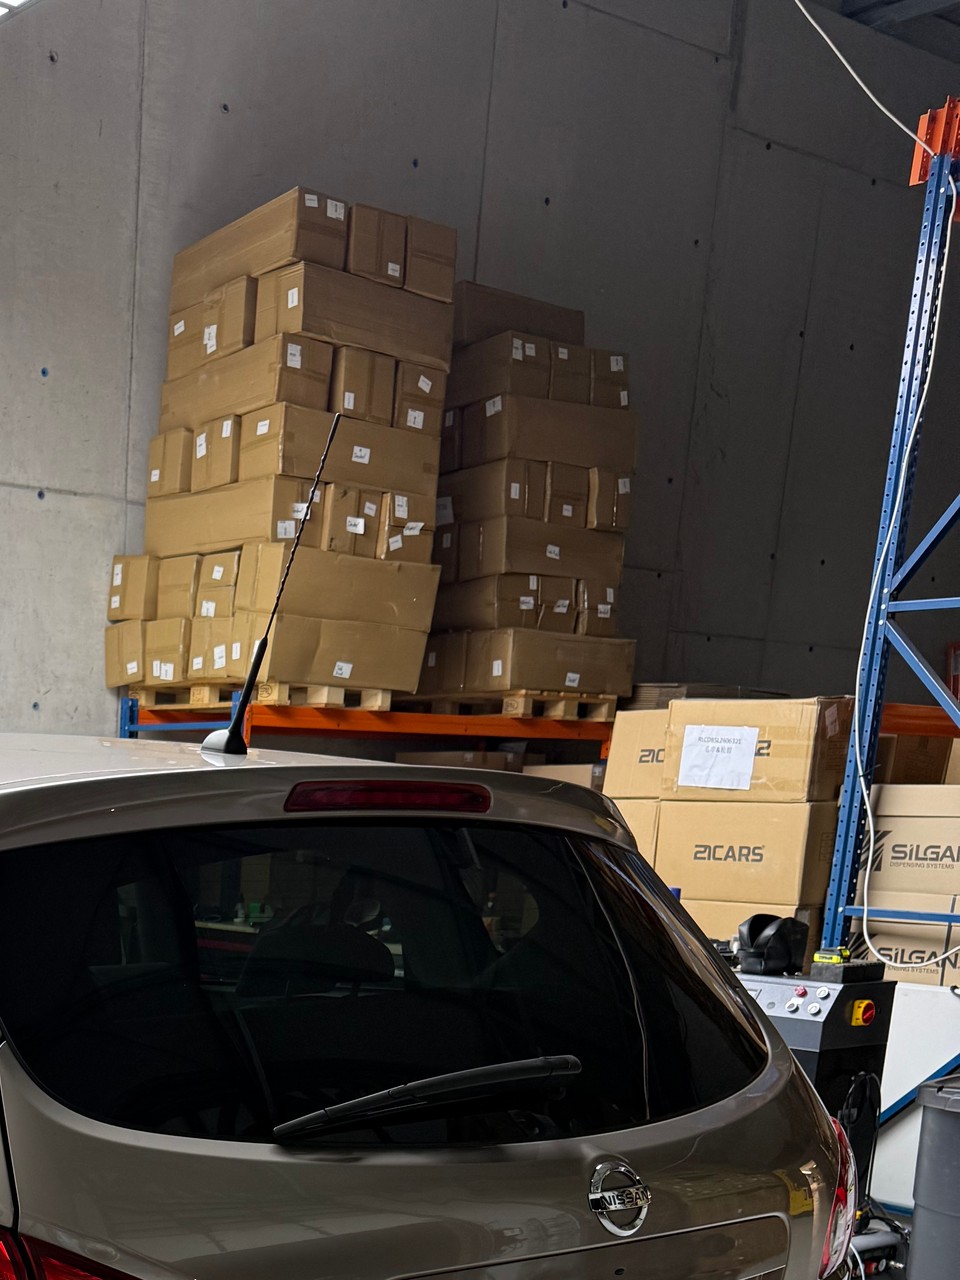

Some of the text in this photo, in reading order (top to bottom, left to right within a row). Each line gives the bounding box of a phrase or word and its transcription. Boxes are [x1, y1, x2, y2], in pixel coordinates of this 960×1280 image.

[693, 844, 764, 863] 21CARS
[889, 861, 955, 870] DISPENSING SYSTEMS
[600, 1190, 649, 1206] NISSAN
